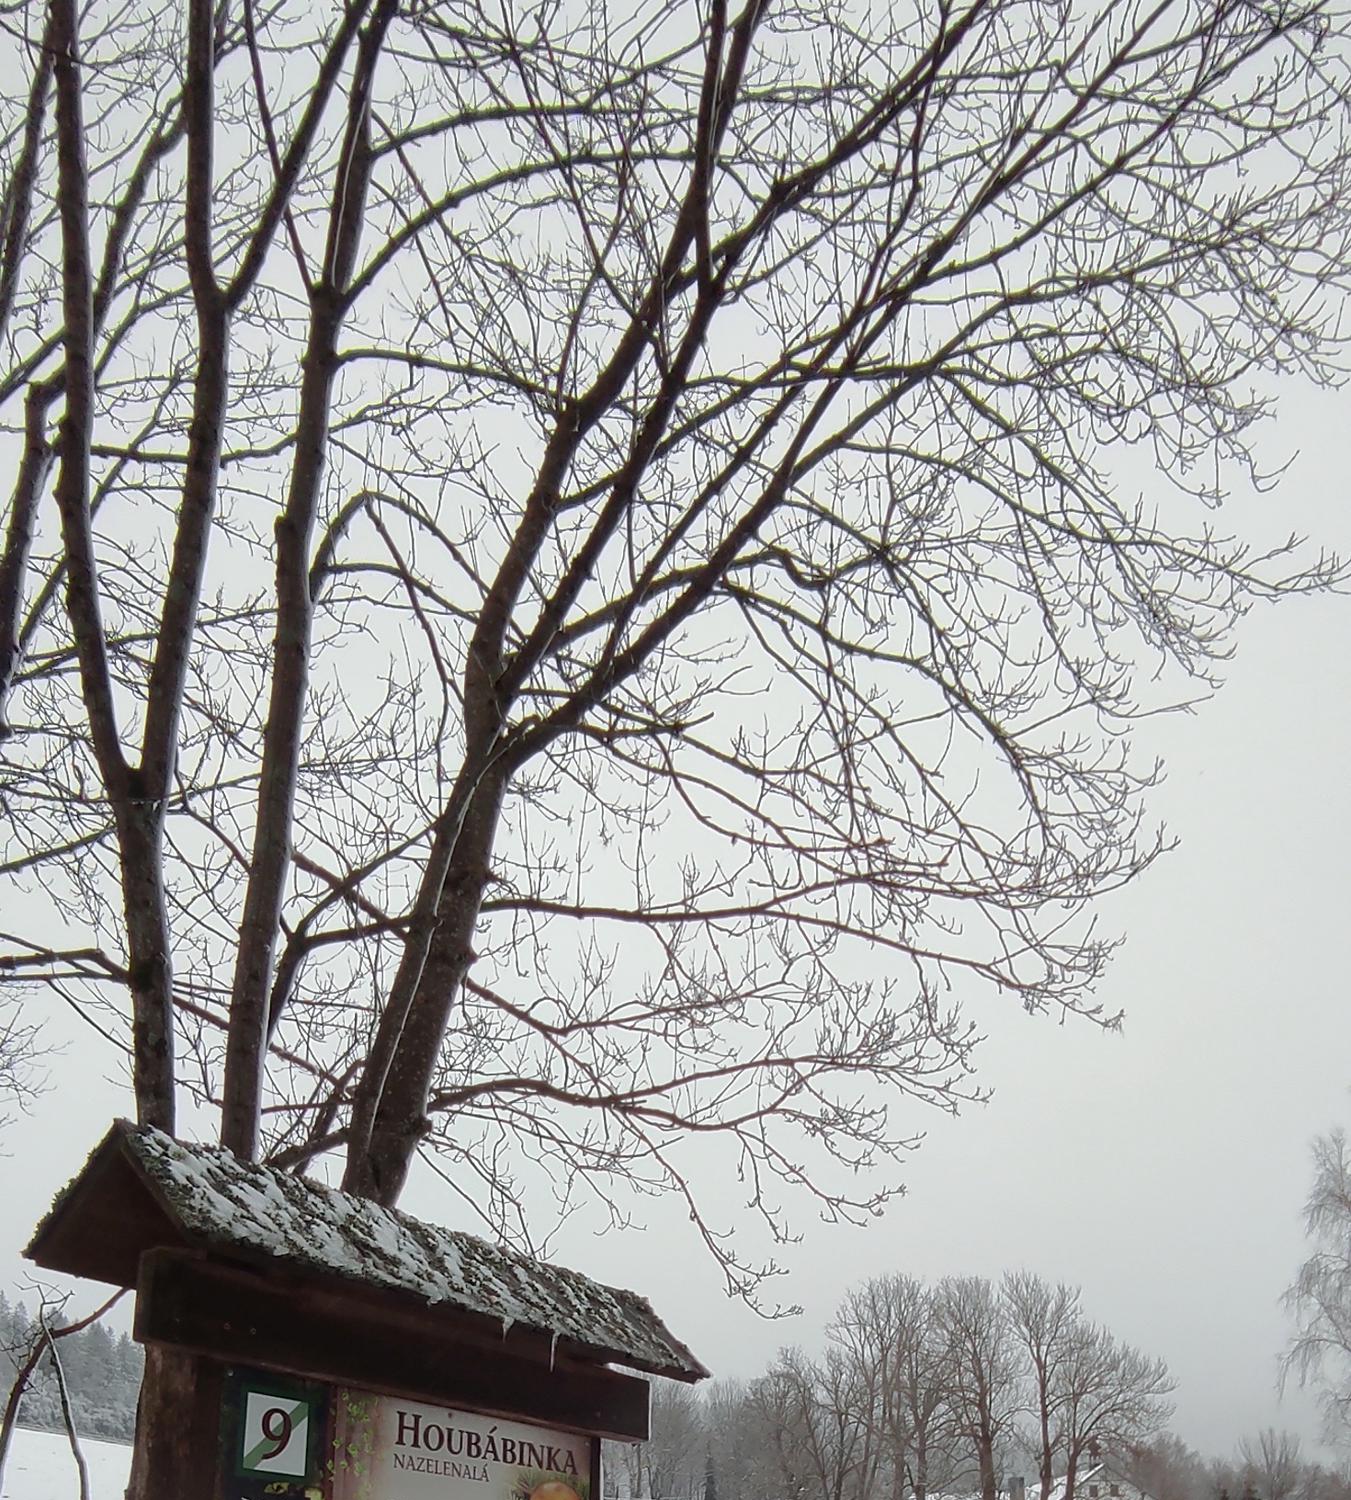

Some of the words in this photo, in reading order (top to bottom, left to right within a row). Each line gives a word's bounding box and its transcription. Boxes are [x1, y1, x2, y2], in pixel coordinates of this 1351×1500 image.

[261, 1407, 293, 1460] 9
[395, 1411, 579, 1475] HOUBÁBINKA
[393, 1453, 490, 1482] NAZELENALÁ
